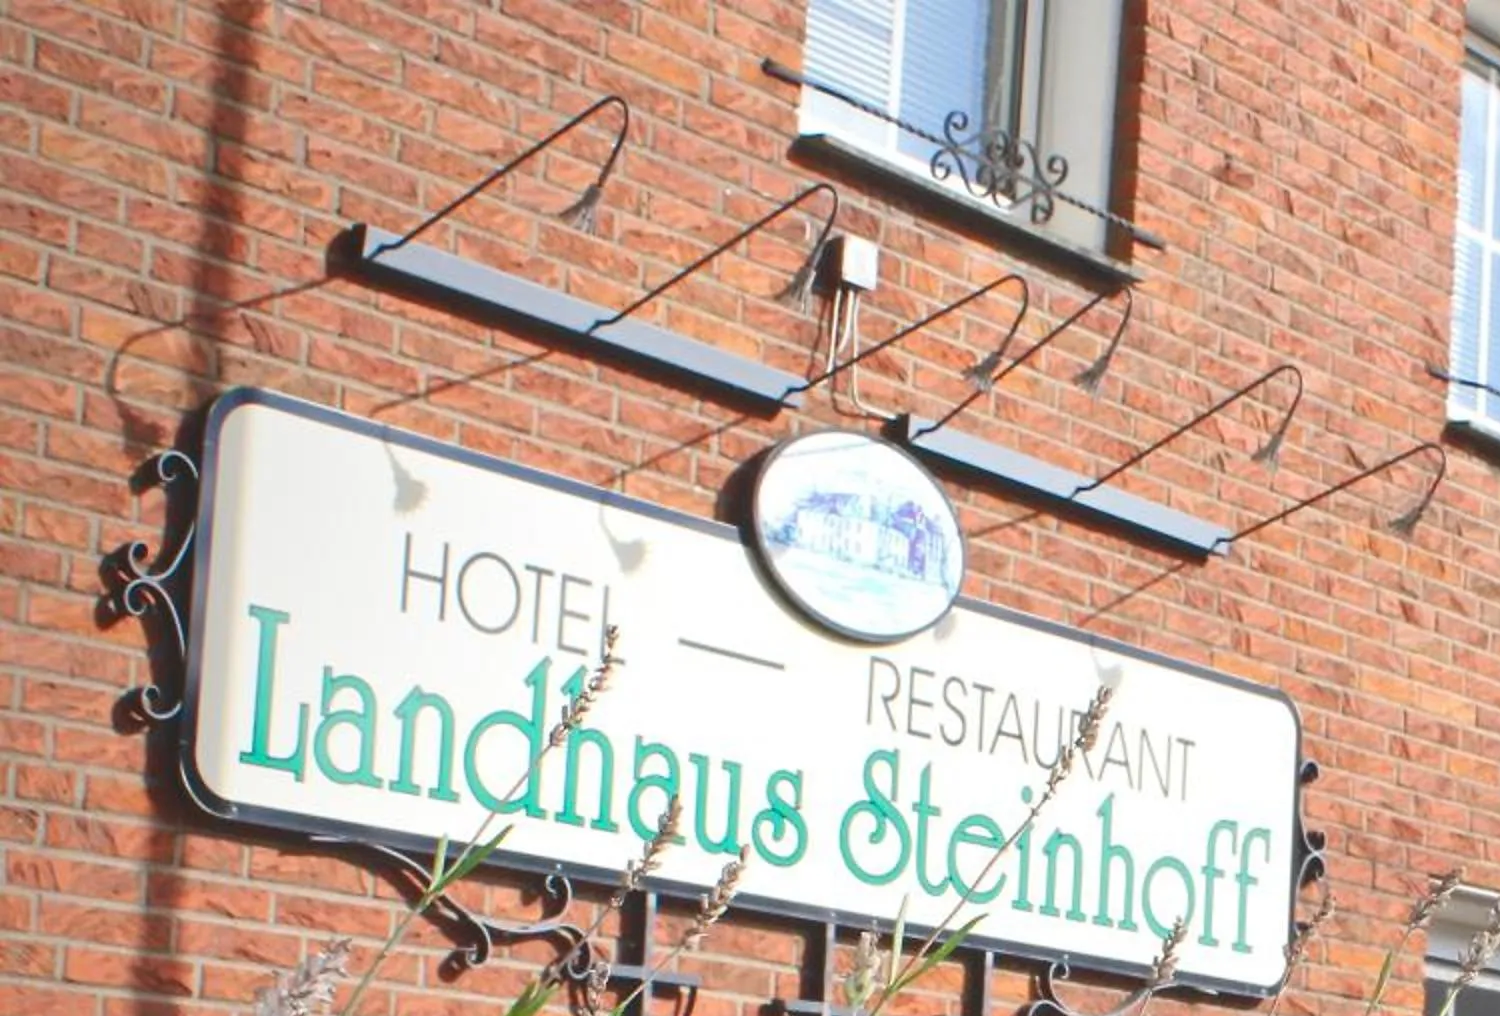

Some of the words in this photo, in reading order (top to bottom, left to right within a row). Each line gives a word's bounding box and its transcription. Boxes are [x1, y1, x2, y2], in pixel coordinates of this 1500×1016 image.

[401, 531, 626, 666] HOTEL
[239, 603, 805, 868] Landhaus
[839, 748, 1272, 954] Steinhoff
